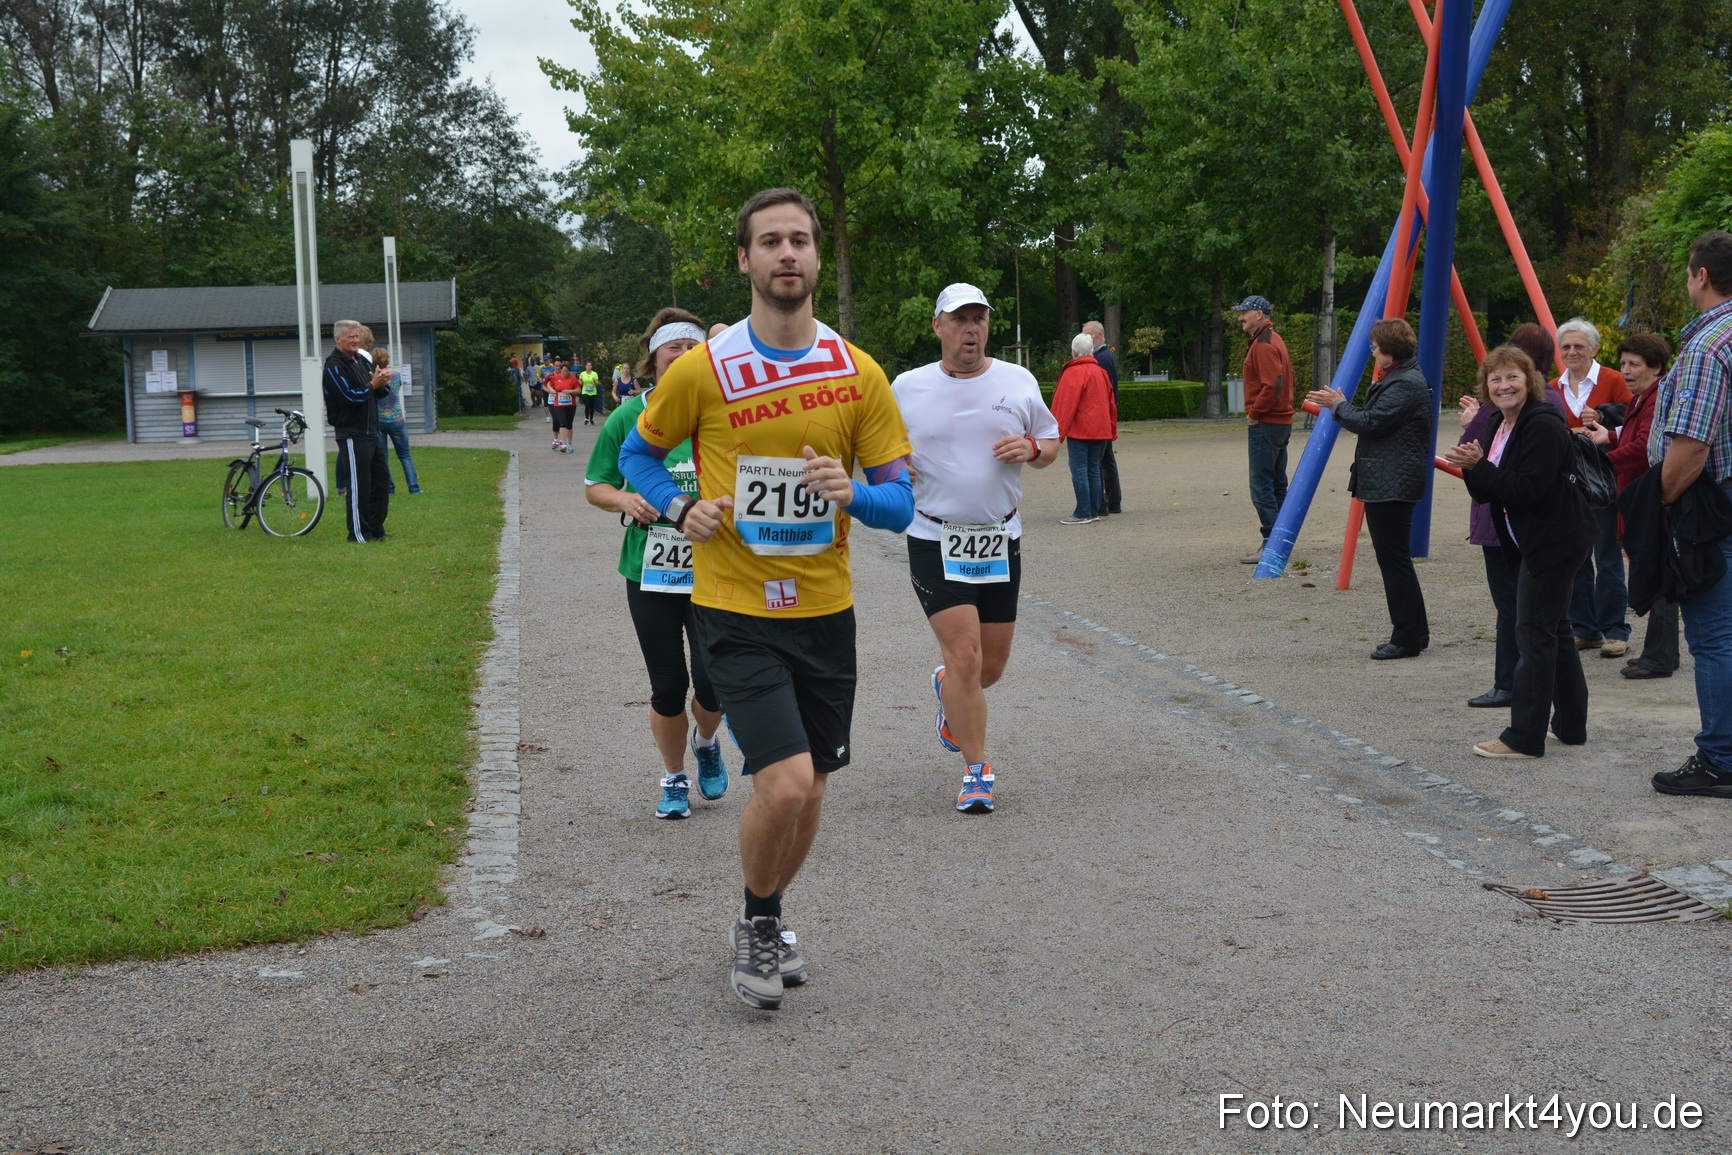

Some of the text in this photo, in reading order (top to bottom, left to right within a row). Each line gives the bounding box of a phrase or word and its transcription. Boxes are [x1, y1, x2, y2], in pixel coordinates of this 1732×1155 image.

[728, 385, 863, 429] MAX BÖGL
[739, 465, 776, 477] PARTL
[746, 480, 829, 518] 2195
[649, 531, 670, 541] PARTL
[758, 526, 814, 542] Matthias
[942, 524, 966, 533] PARTL
[948, 534, 1004, 559] 2422
[651, 542, 693, 569] 242
[959, 564, 991, 575] Herbert
